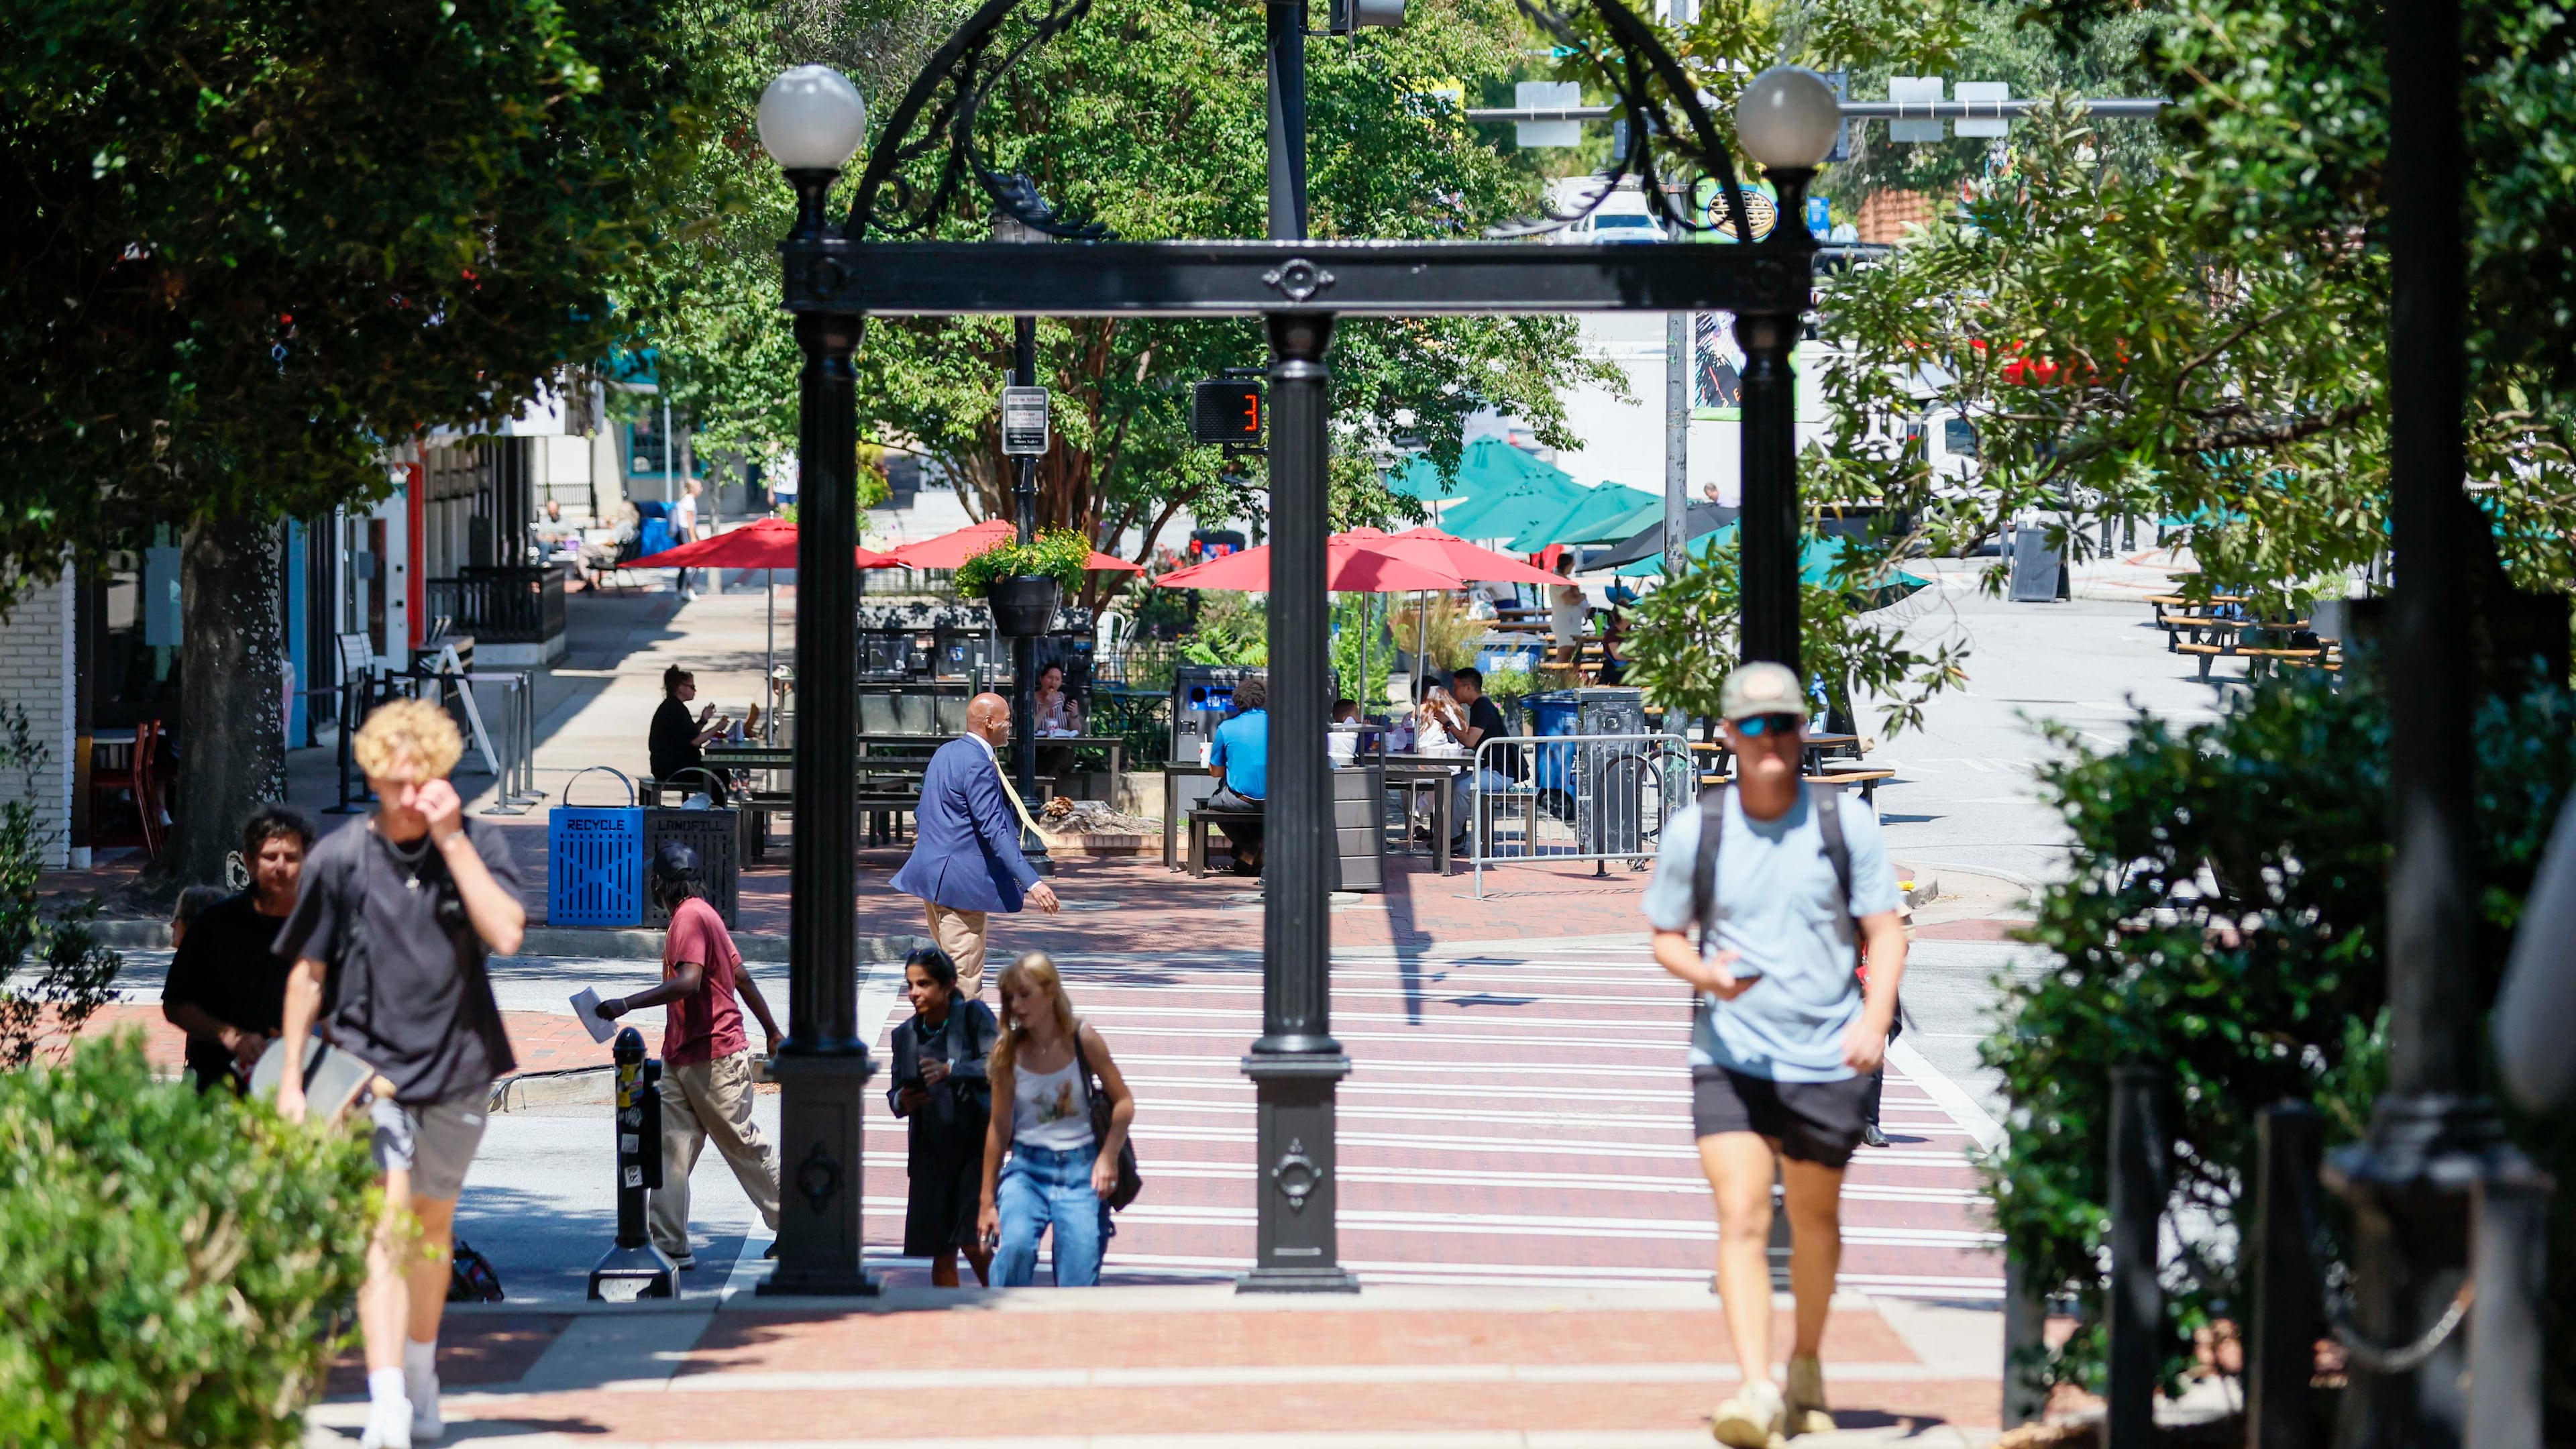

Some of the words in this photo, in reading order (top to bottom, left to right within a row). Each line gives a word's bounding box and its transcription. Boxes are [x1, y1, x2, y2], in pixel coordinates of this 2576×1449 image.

[1244, 394, 1256, 431] 3
[567, 819, 625, 830] RECYCLE
[658, 820, 724, 832] LANDFILL
